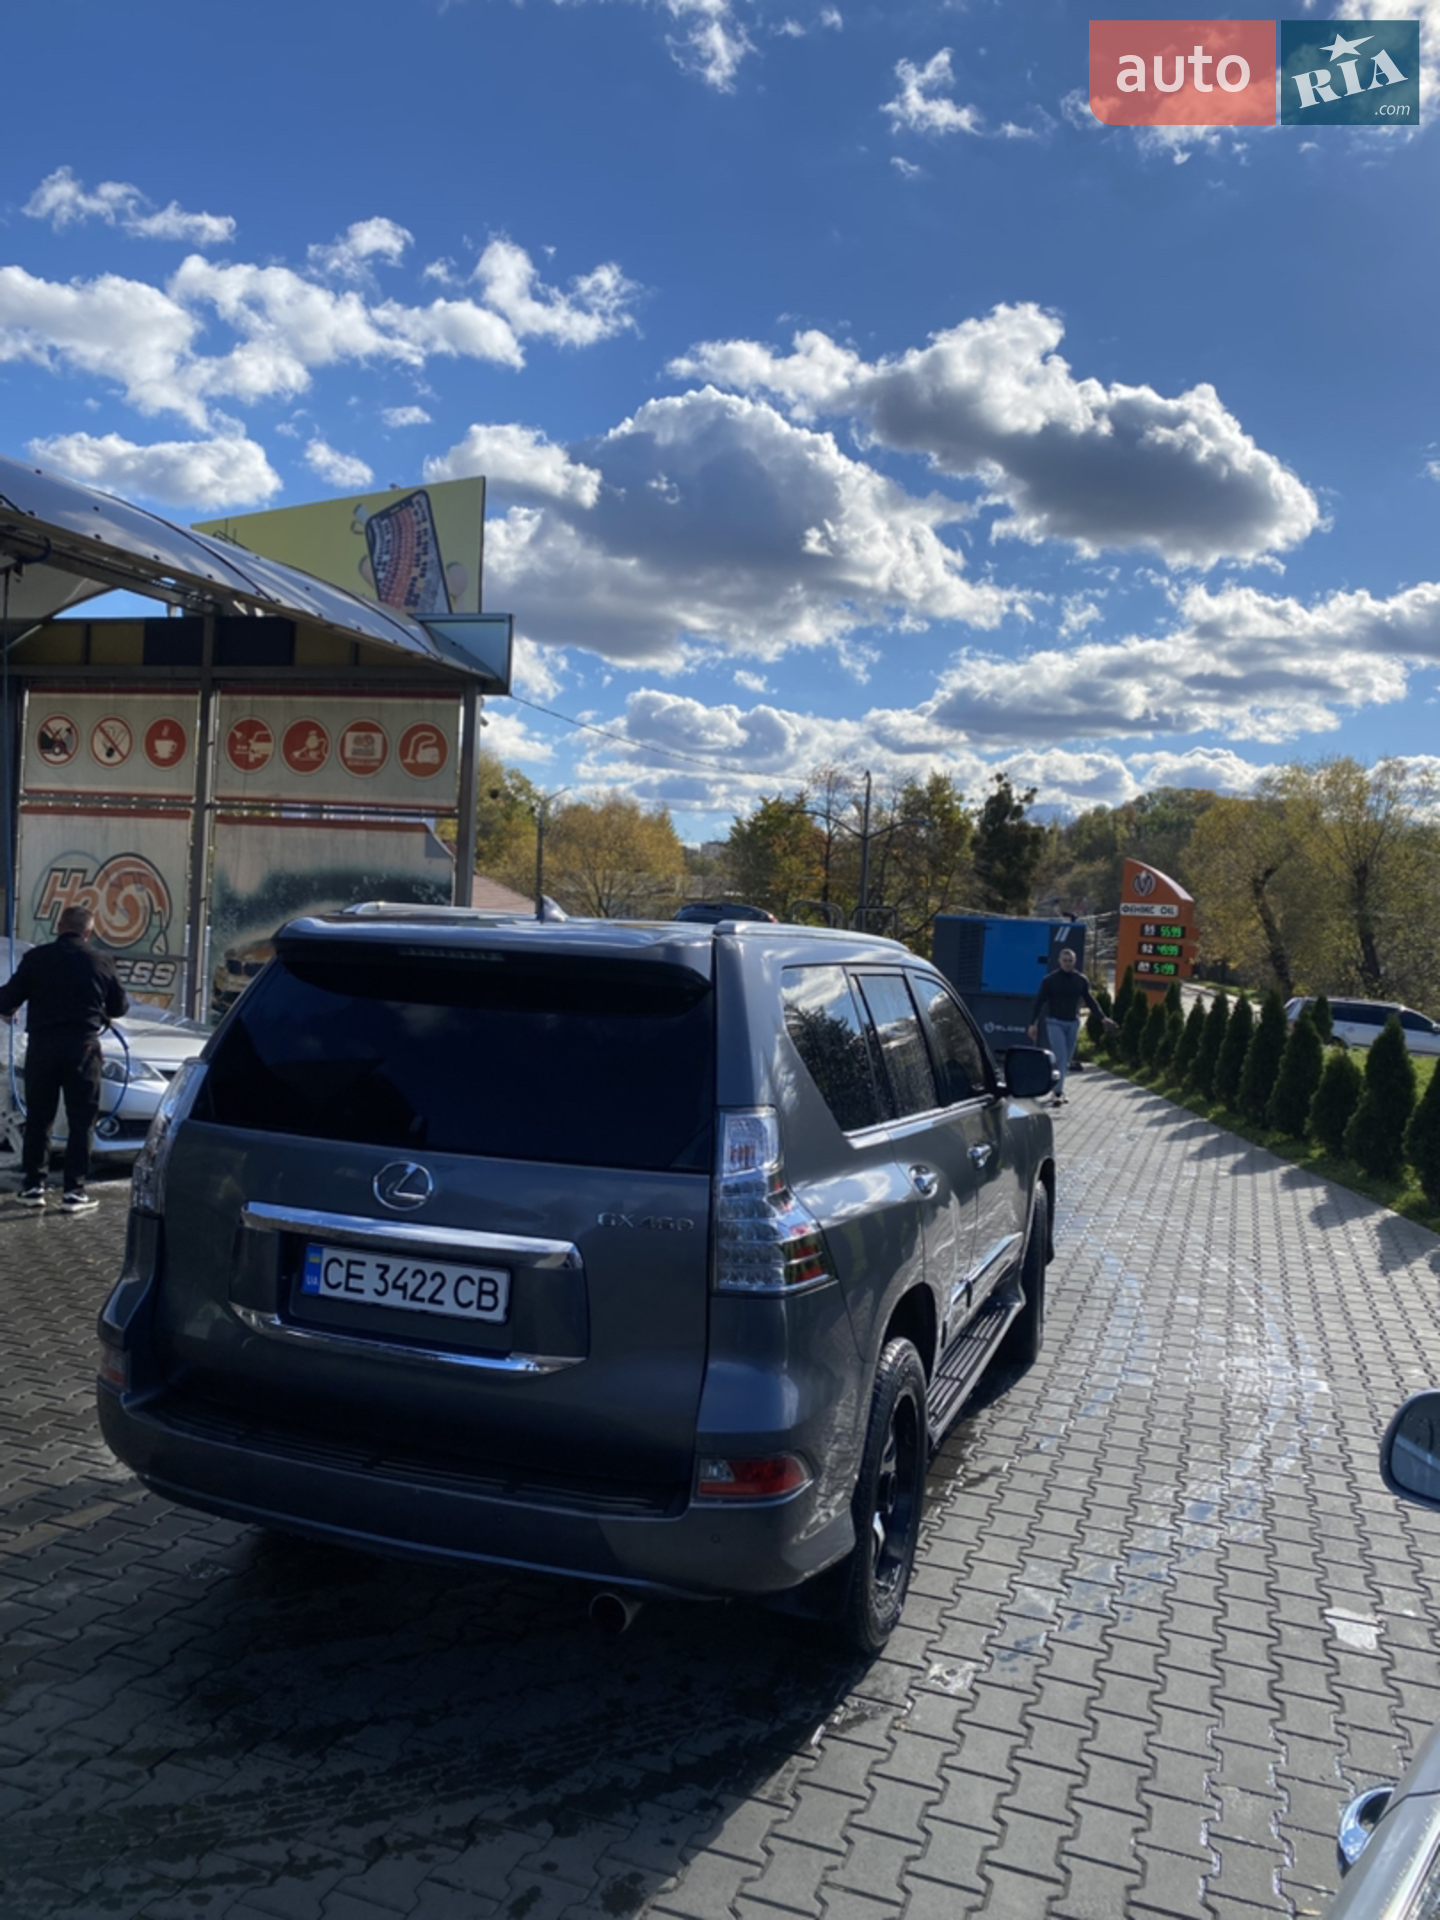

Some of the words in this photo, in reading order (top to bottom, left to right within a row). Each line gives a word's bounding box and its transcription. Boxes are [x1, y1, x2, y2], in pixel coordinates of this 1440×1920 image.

[597, 1211, 634, 1228] GX
[323, 1257, 367, 1295] CE
[373, 1263, 447, 1306] 3422
[453, 1275, 500, 1313] CB
